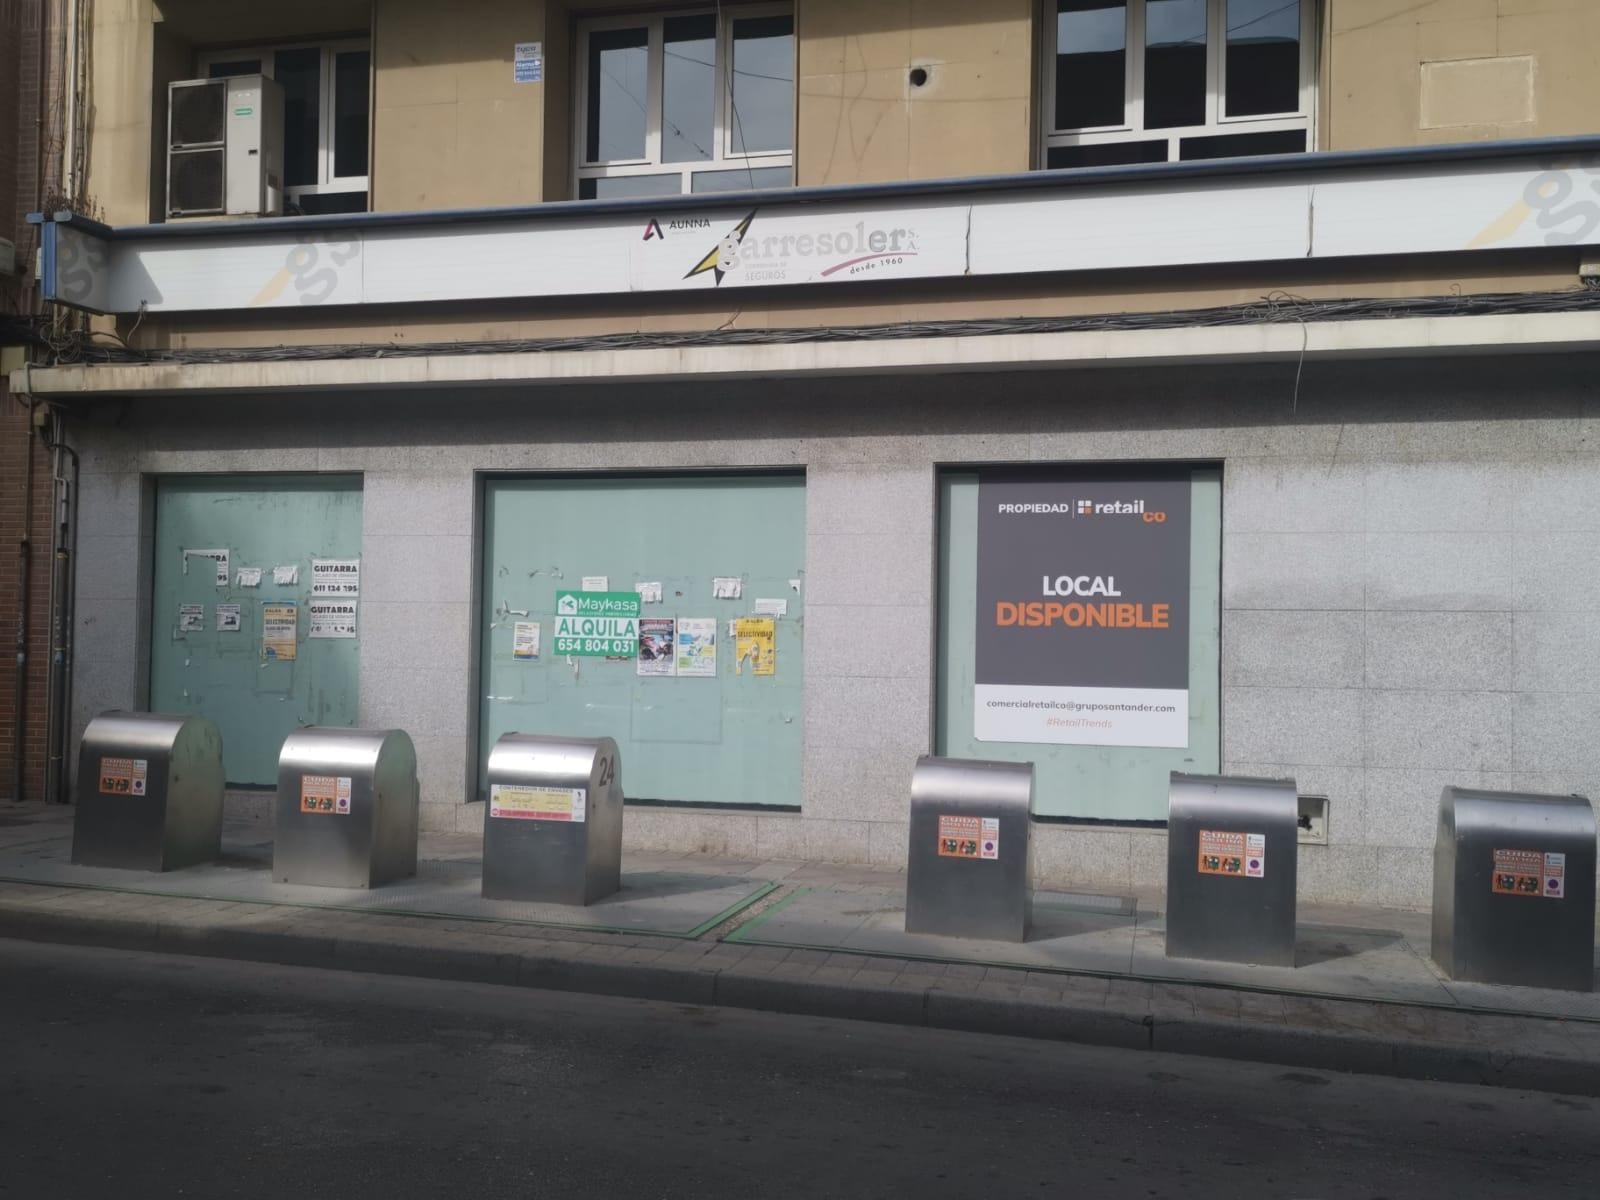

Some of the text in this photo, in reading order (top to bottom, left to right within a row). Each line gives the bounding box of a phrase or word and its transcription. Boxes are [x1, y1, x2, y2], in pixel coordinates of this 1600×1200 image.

[669, 218, 711, 229] AUNNA
[880, 257, 903, 267] 1960
[744, 271, 787, 281] SEGUROS
[998, 503, 1069, 514] PROPIEDAD
[1095, 500, 1144, 514] retail
[314, 565, 357, 573] GUITARRA
[1042, 575, 1122, 597] LOCAL
[310, 606, 354, 614] GUITARRA
[578, 597, 638, 612] Maykasa
[996, 602, 1170, 629] DISPONIBLE
[558, 618, 636, 637] ALQUILA
[558, 638, 635, 653] 654 804 031
[986, 699, 1176, 713] comercialretailco@gruposantander.com
[1046, 717, 1113, 729] #RetailTrends
[598, 755, 615, 787] 24
